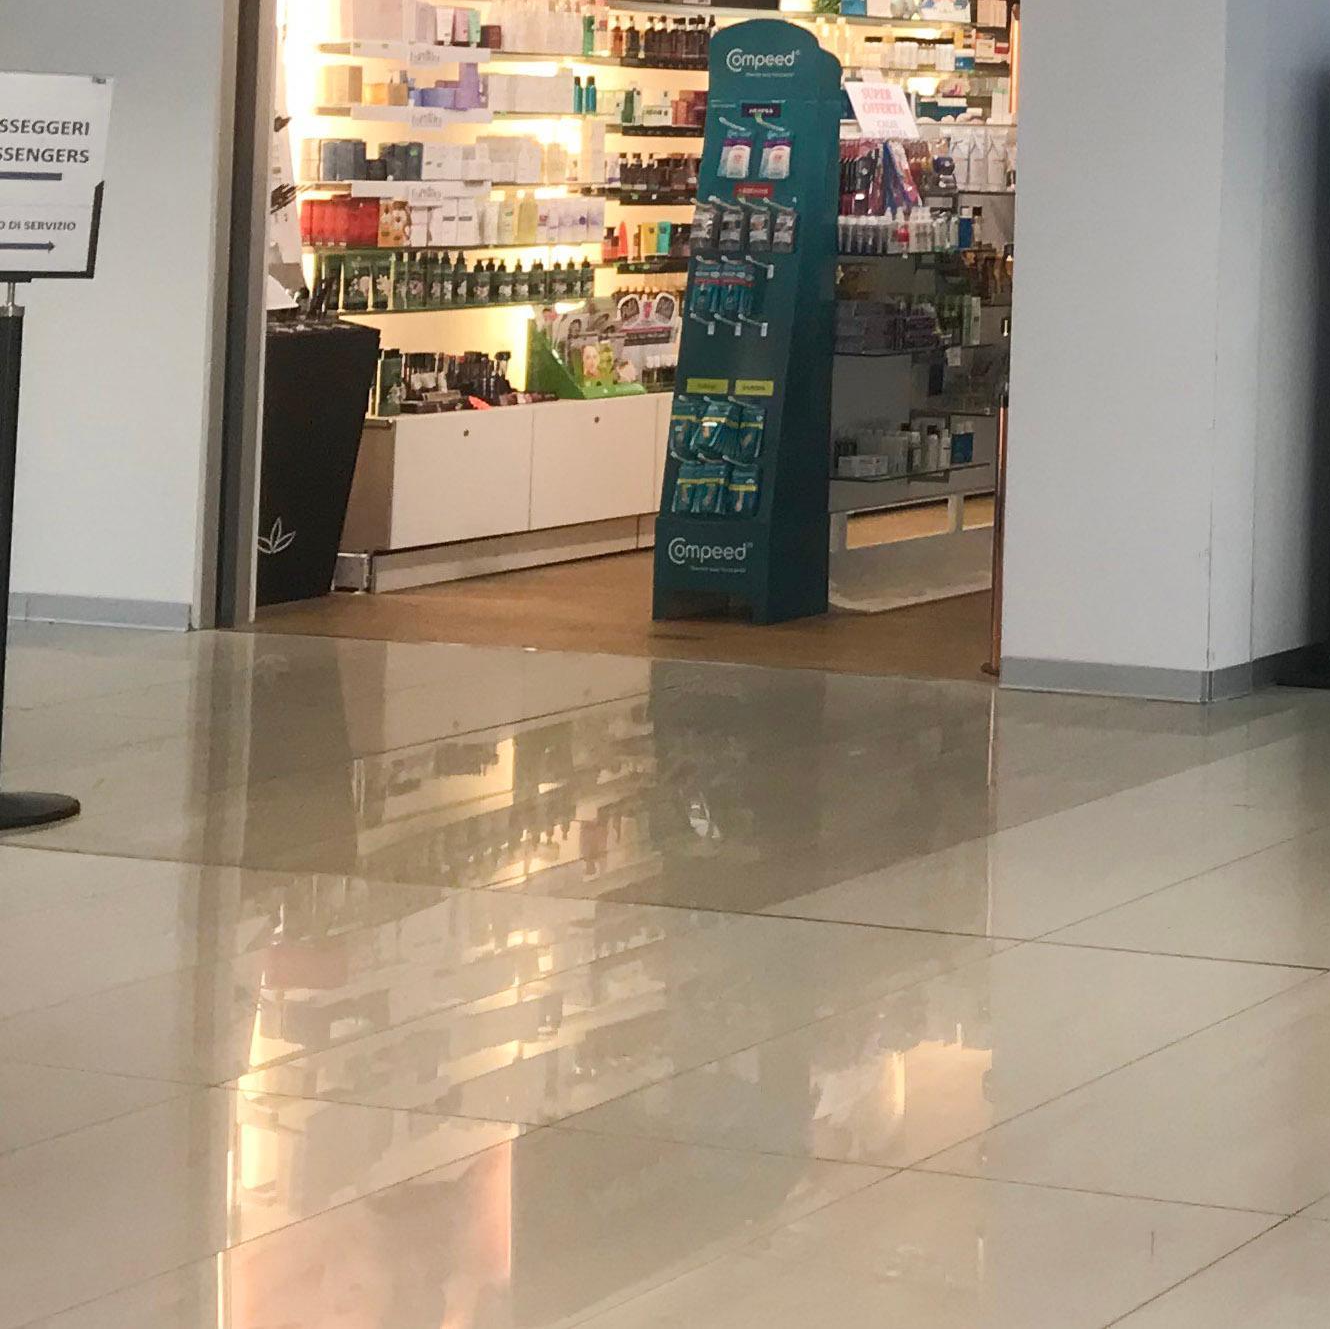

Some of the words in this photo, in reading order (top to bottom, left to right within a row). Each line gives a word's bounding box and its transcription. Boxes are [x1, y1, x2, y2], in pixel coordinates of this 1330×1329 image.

[726, 48, 796, 72] Compeed
[861, 87, 893, 100] SUPER
[862, 102, 905, 116] OFFERTA
[8, 220, 21, 231] DI
[24, 220, 76, 231] SERVIZIO
[668, 537, 747, 564] Compeed
